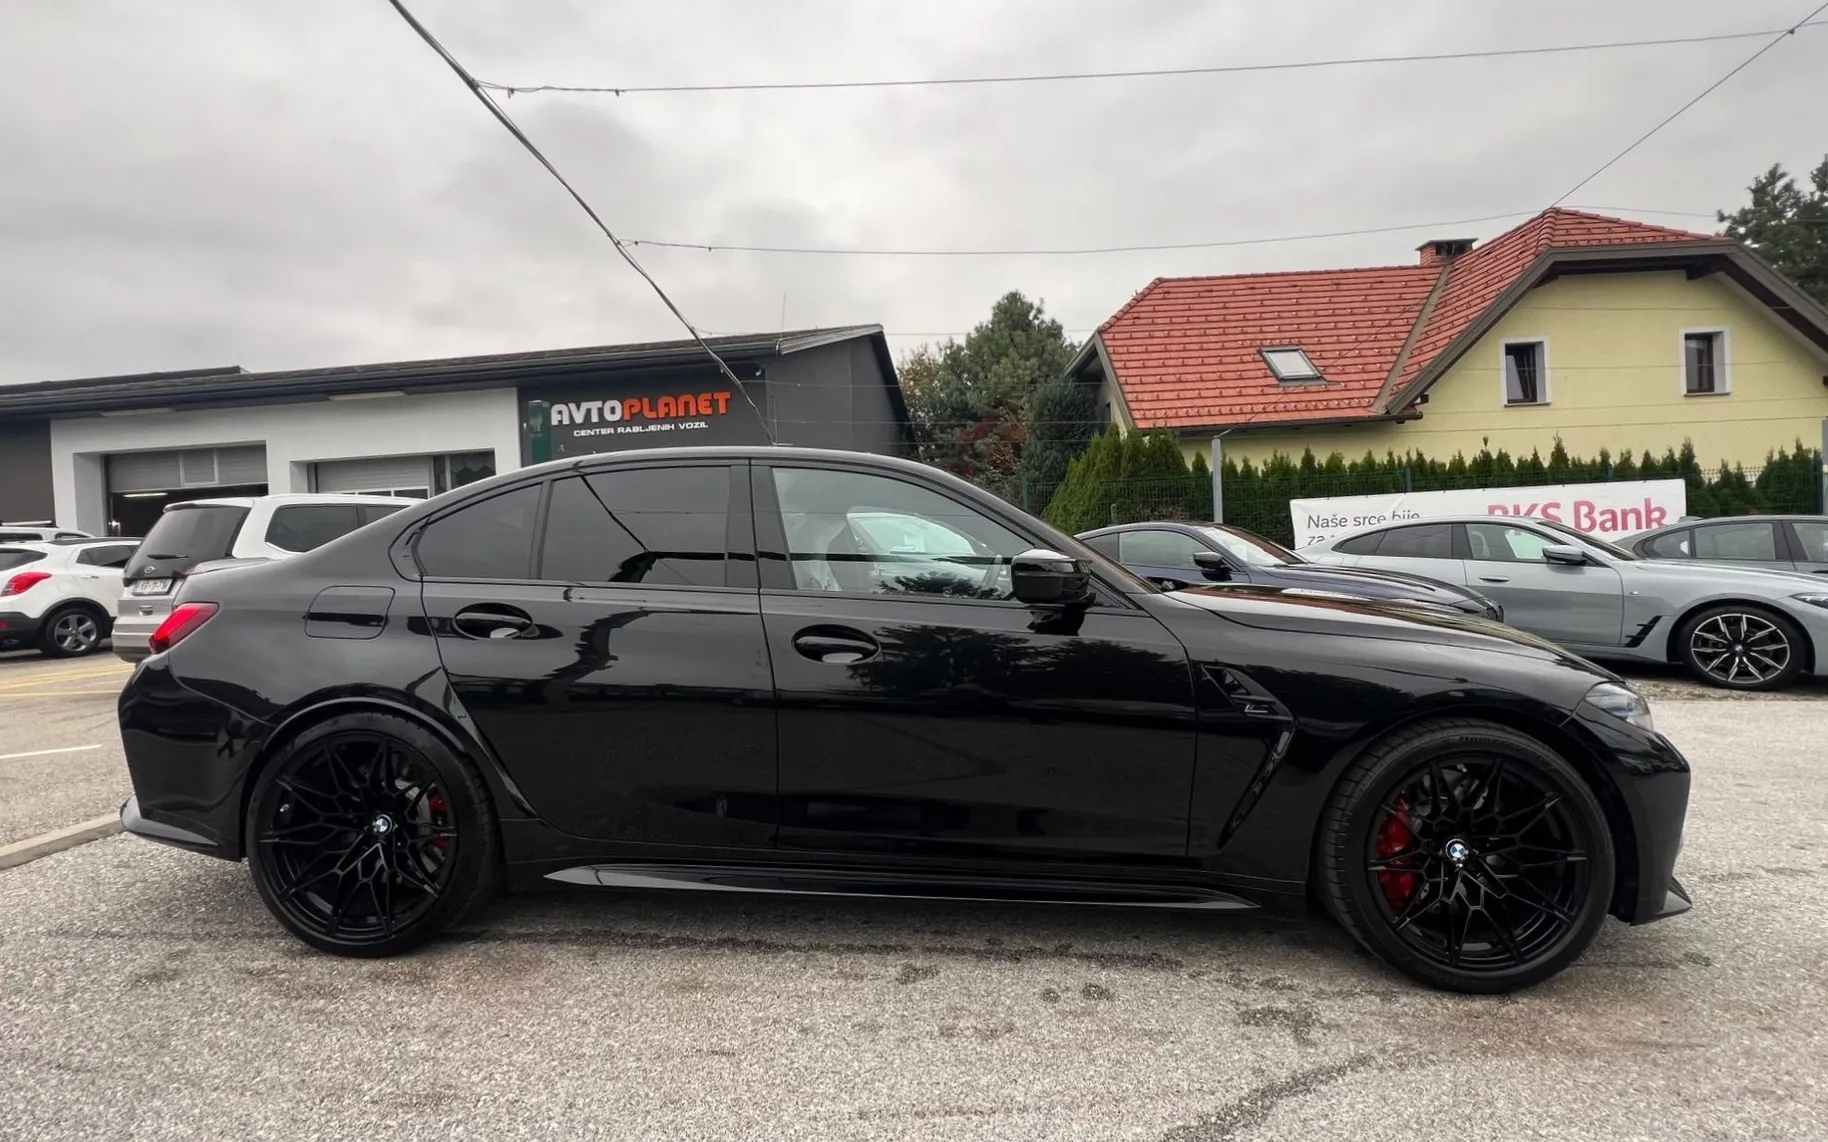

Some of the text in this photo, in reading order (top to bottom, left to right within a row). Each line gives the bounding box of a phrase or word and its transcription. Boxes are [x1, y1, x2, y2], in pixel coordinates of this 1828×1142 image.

[551, 391, 731, 425] AVTOPLANET
[573, 421, 708, 437] CENTER RABLJENIH VOZIL
[1307, 513, 1348, 529] Naše
[1353, 515, 1386, 526] srce
[1573, 497, 1669, 533] Bank
